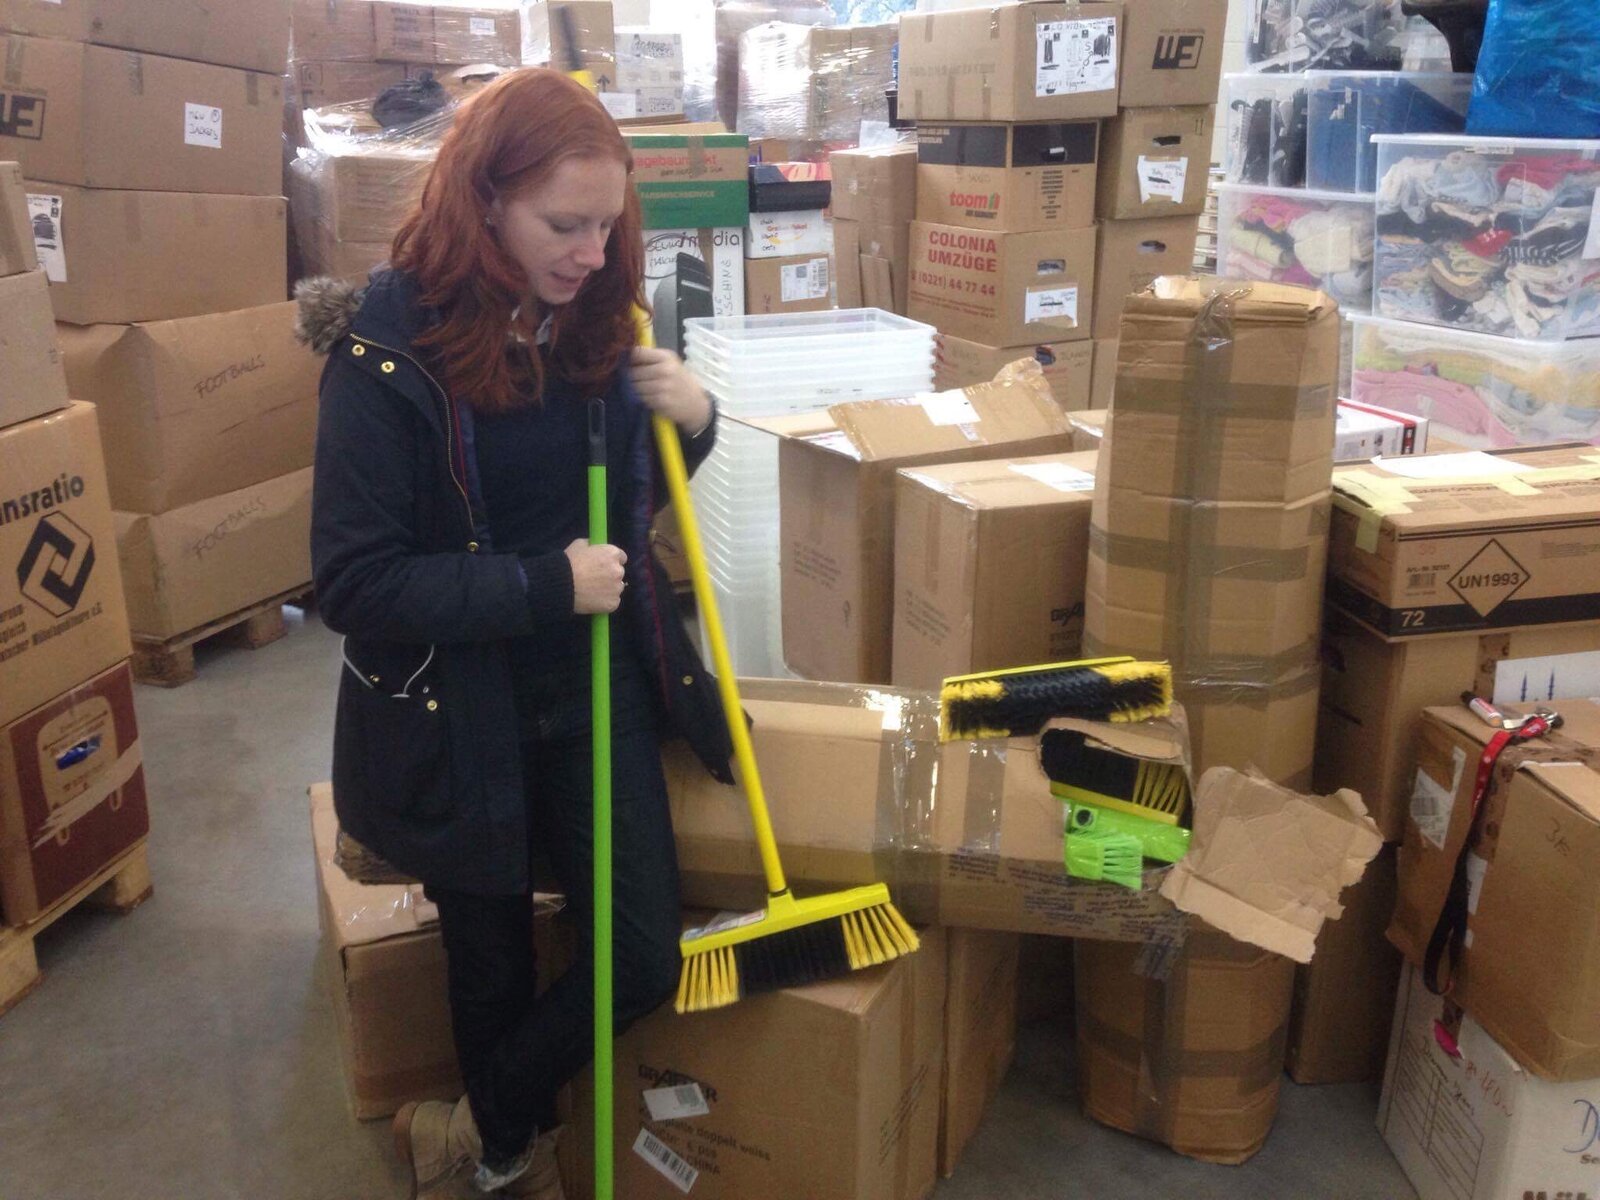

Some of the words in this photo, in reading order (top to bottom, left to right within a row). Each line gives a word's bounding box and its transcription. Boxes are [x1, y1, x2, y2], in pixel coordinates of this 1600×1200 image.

[950, 191, 988, 209] toom
[929, 230, 997, 253] COLONIA
[928, 249, 997, 273] UMZÜGE
[918, 273, 947, 290] (0221)
[949, 279, 962, 291] 44
[965, 282, 977, 293] 77
[981, 284, 996, 296] 44
[193, 354, 265, 399] FOOTBALLS
[192, 496, 265, 559] FOOTBALLS
[1459, 572, 1519, 589] UN1993
[1401, 610, 1425, 627] 72
